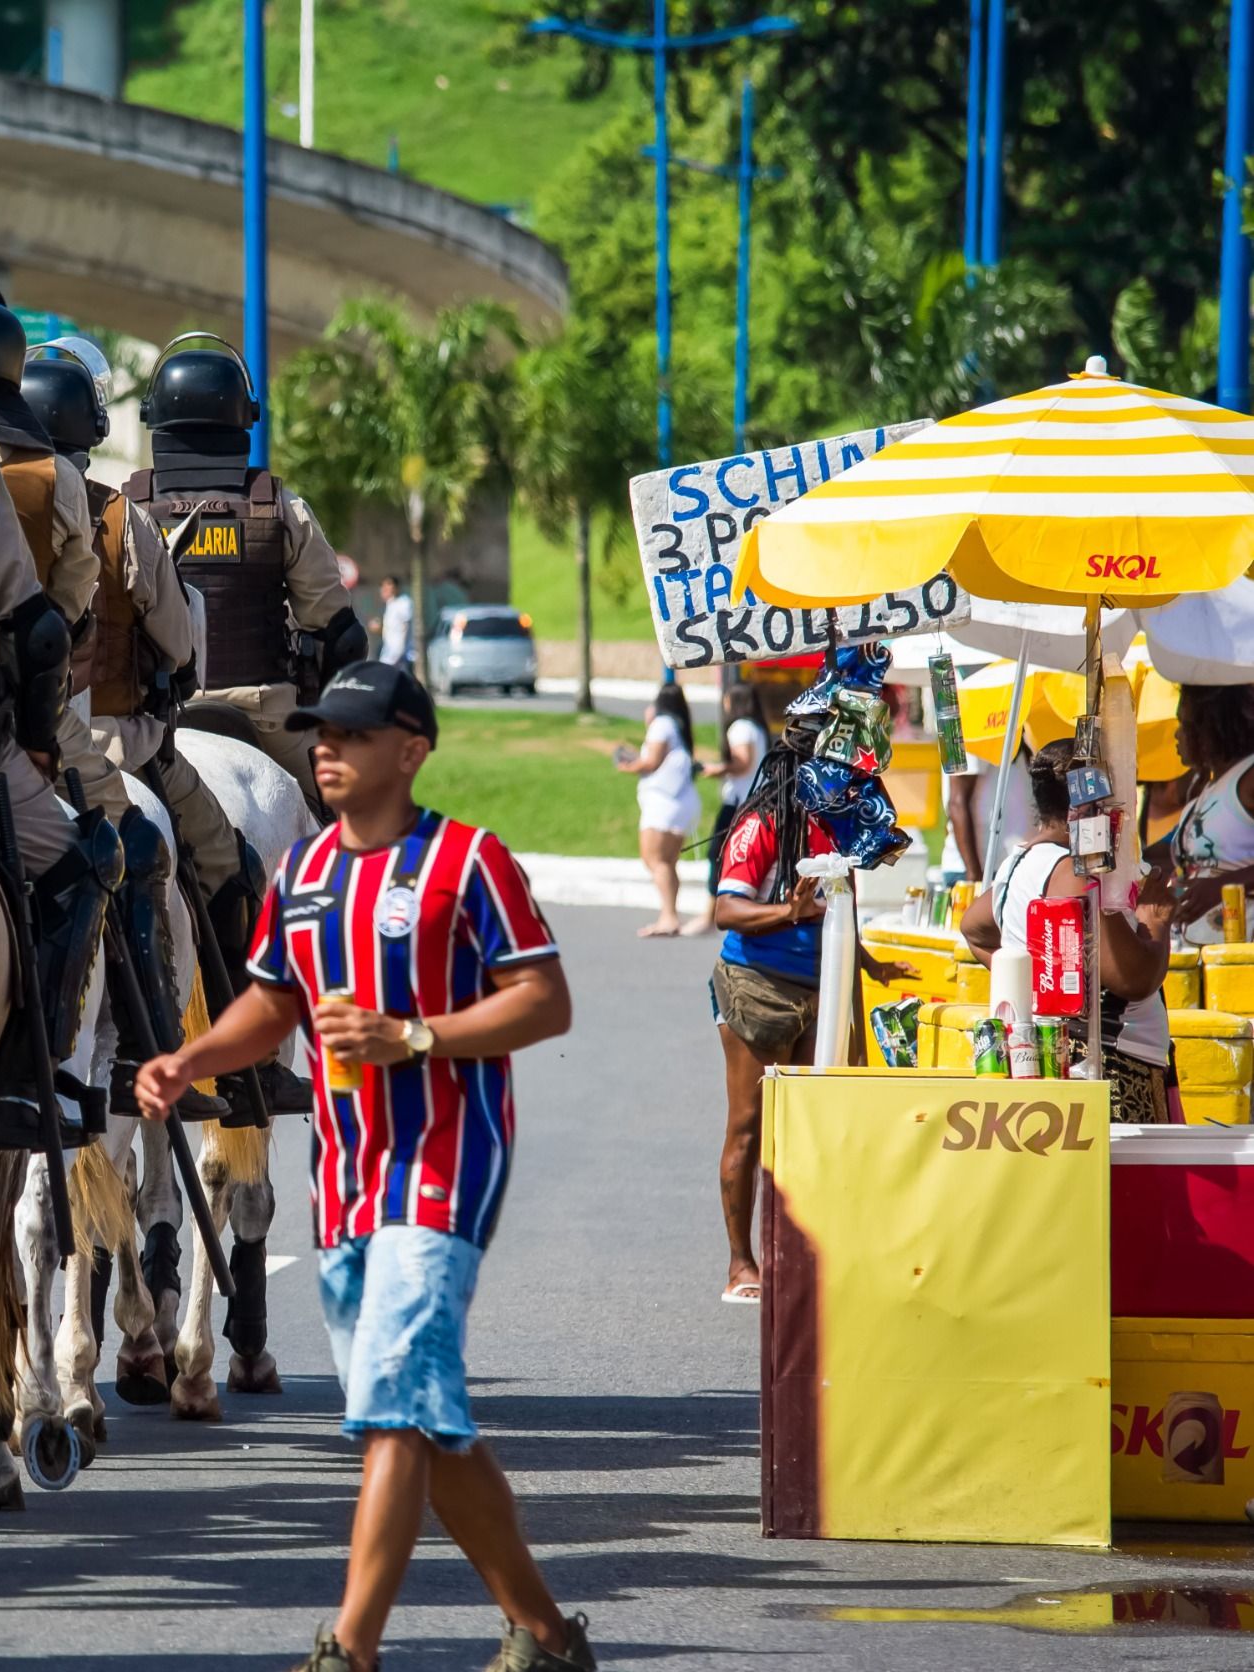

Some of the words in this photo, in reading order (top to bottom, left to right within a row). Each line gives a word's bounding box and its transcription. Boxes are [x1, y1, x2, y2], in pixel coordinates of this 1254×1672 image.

[651, 523, 692, 575] 3
[1086, 554, 1162, 580] SKOL
[676, 605, 830, 668] SKOL
[1039, 918, 1055, 994] Budweiser
[942, 1100, 1095, 1157] SKOL
[1111, 1403, 1251, 1477] SKOL
